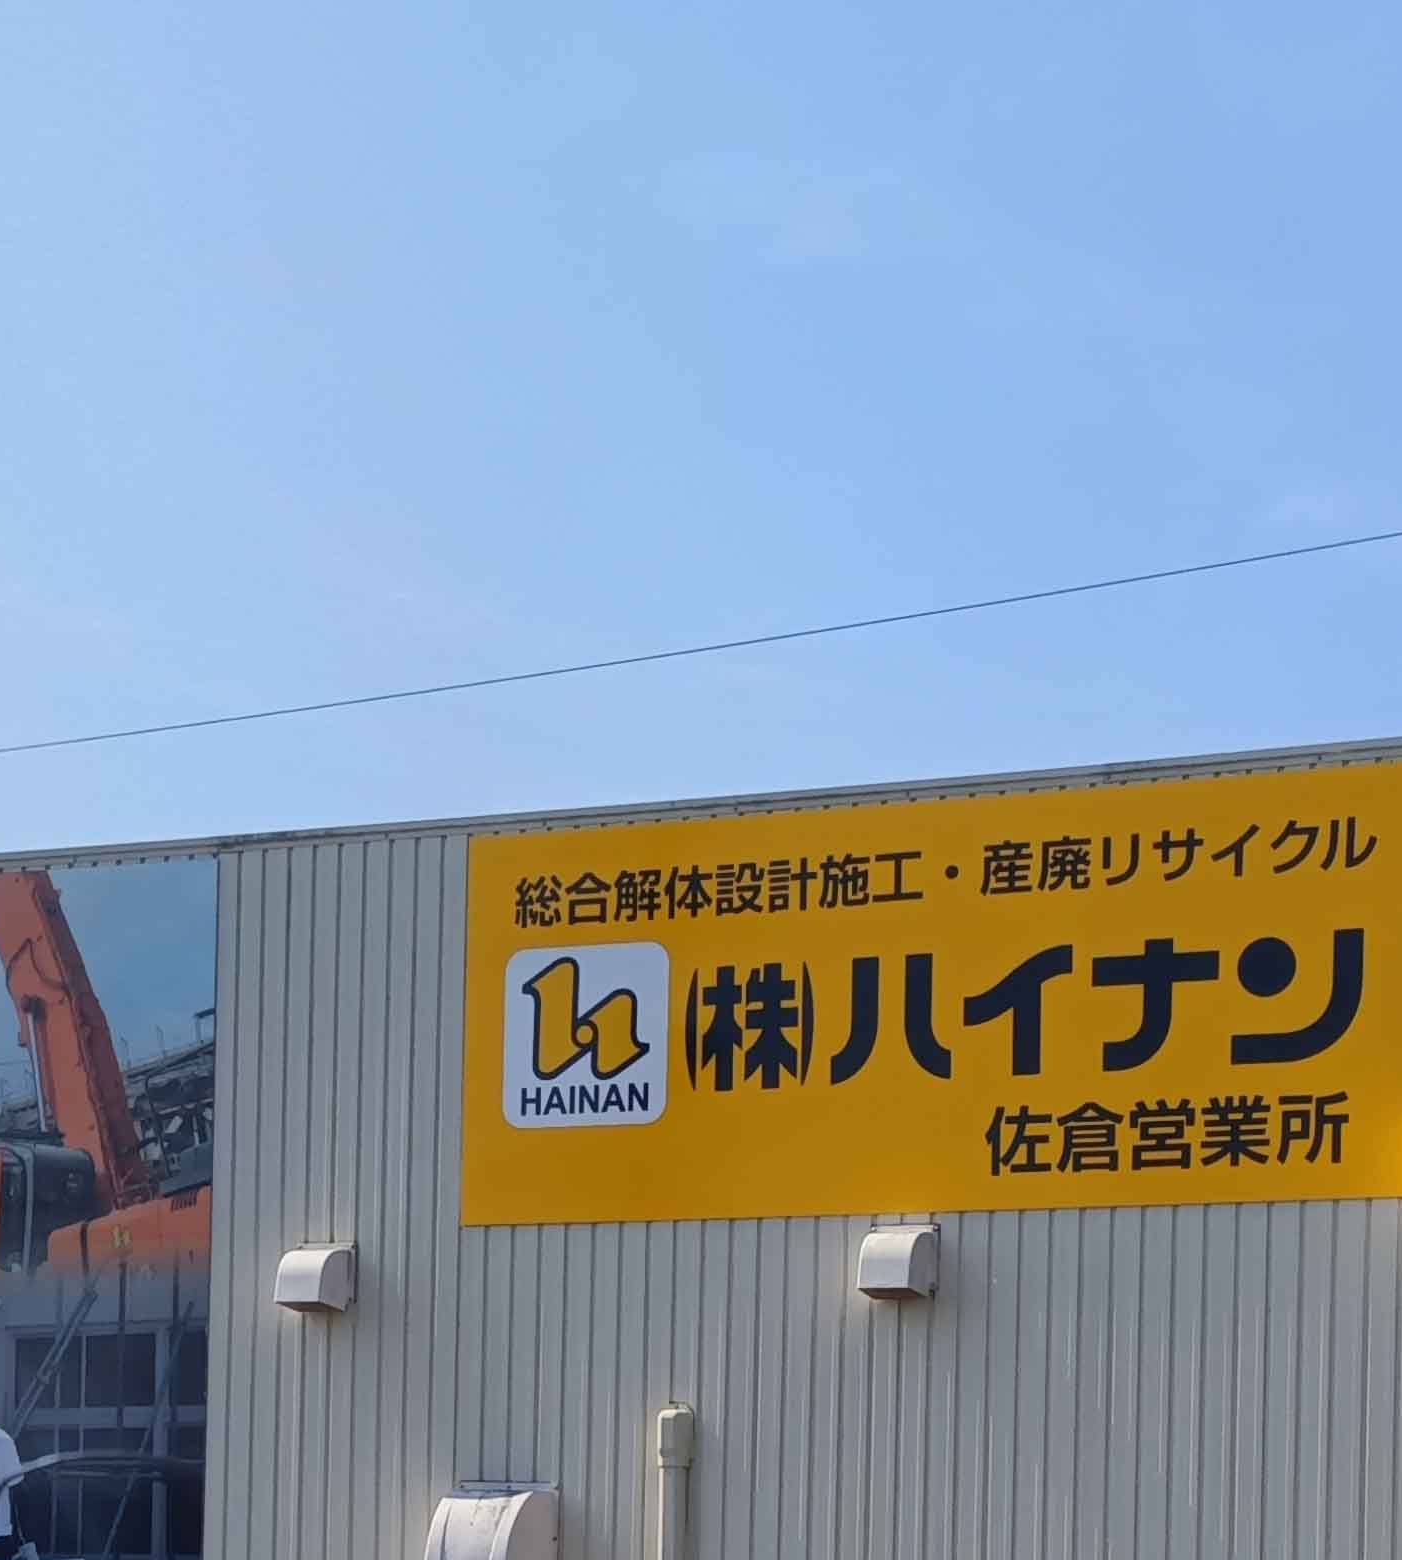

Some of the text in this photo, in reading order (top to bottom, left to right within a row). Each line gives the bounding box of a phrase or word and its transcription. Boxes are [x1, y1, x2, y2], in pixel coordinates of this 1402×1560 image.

[514, 815, 1378, 930] 総合解体設計施工・産廃リサイクル
[520, 1082, 650, 1117] HAINAN
[985, 1091, 1349, 1177] 佐倉営業所
